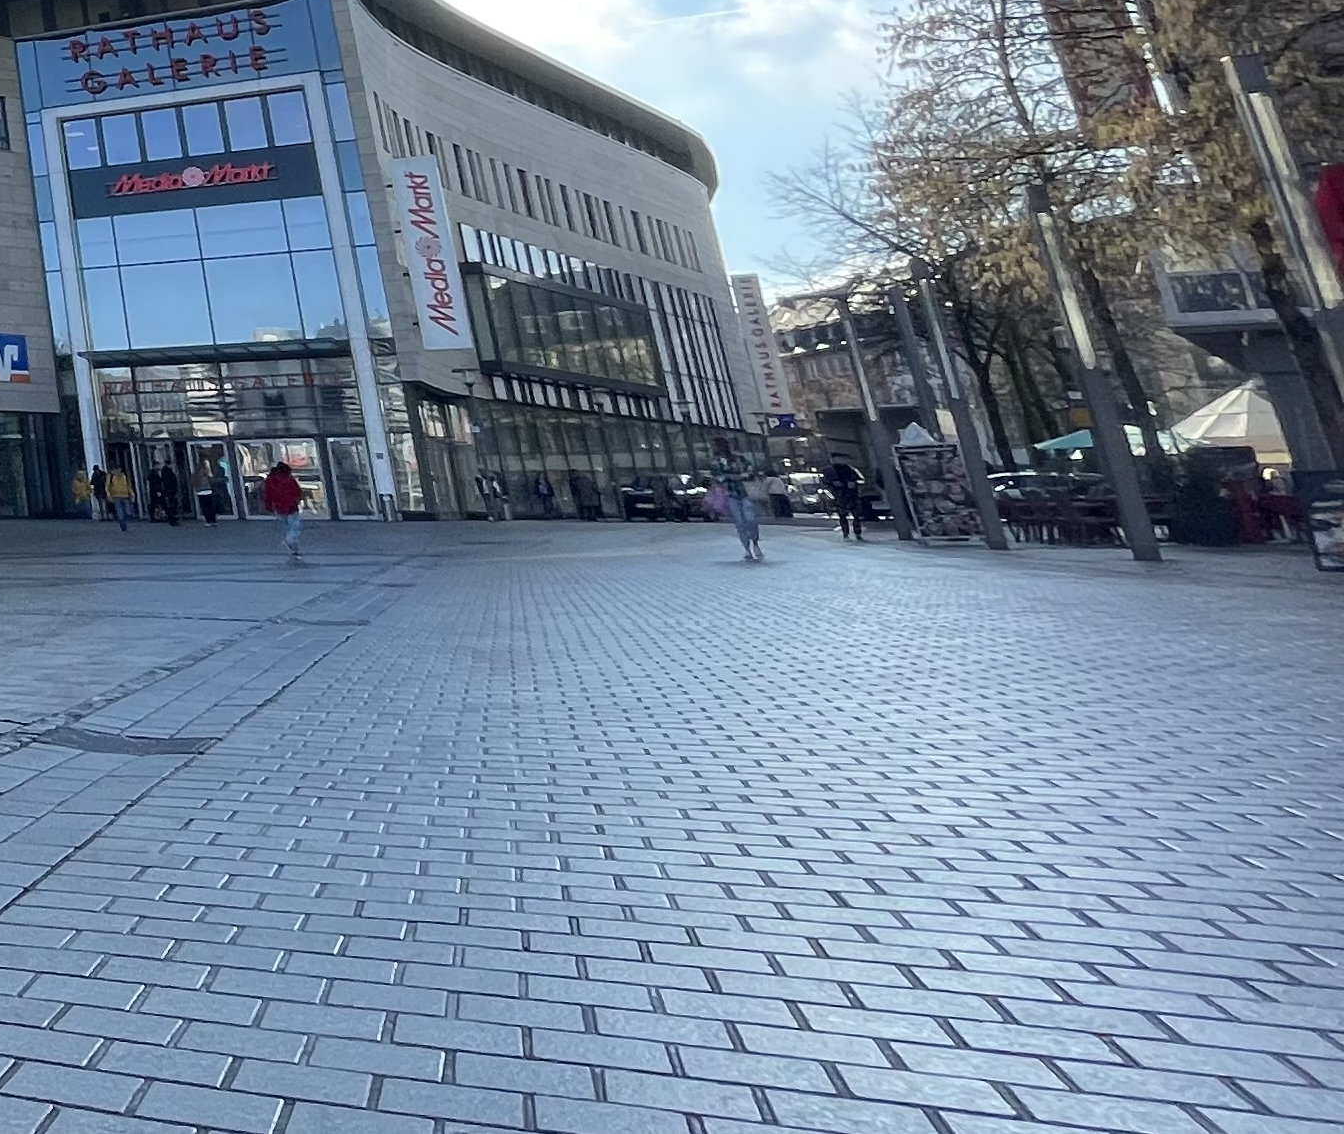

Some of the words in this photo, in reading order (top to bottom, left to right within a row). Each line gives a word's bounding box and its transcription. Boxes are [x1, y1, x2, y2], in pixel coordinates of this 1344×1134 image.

[69, 11, 271, 63] RATHAUS
[81, 46, 268, 94] GALERIE
[112, 173, 185, 194] Media
[204, 162, 272, 184] Markt
[404, 171, 439, 238] Markt
[424, 258, 459, 336] Media
